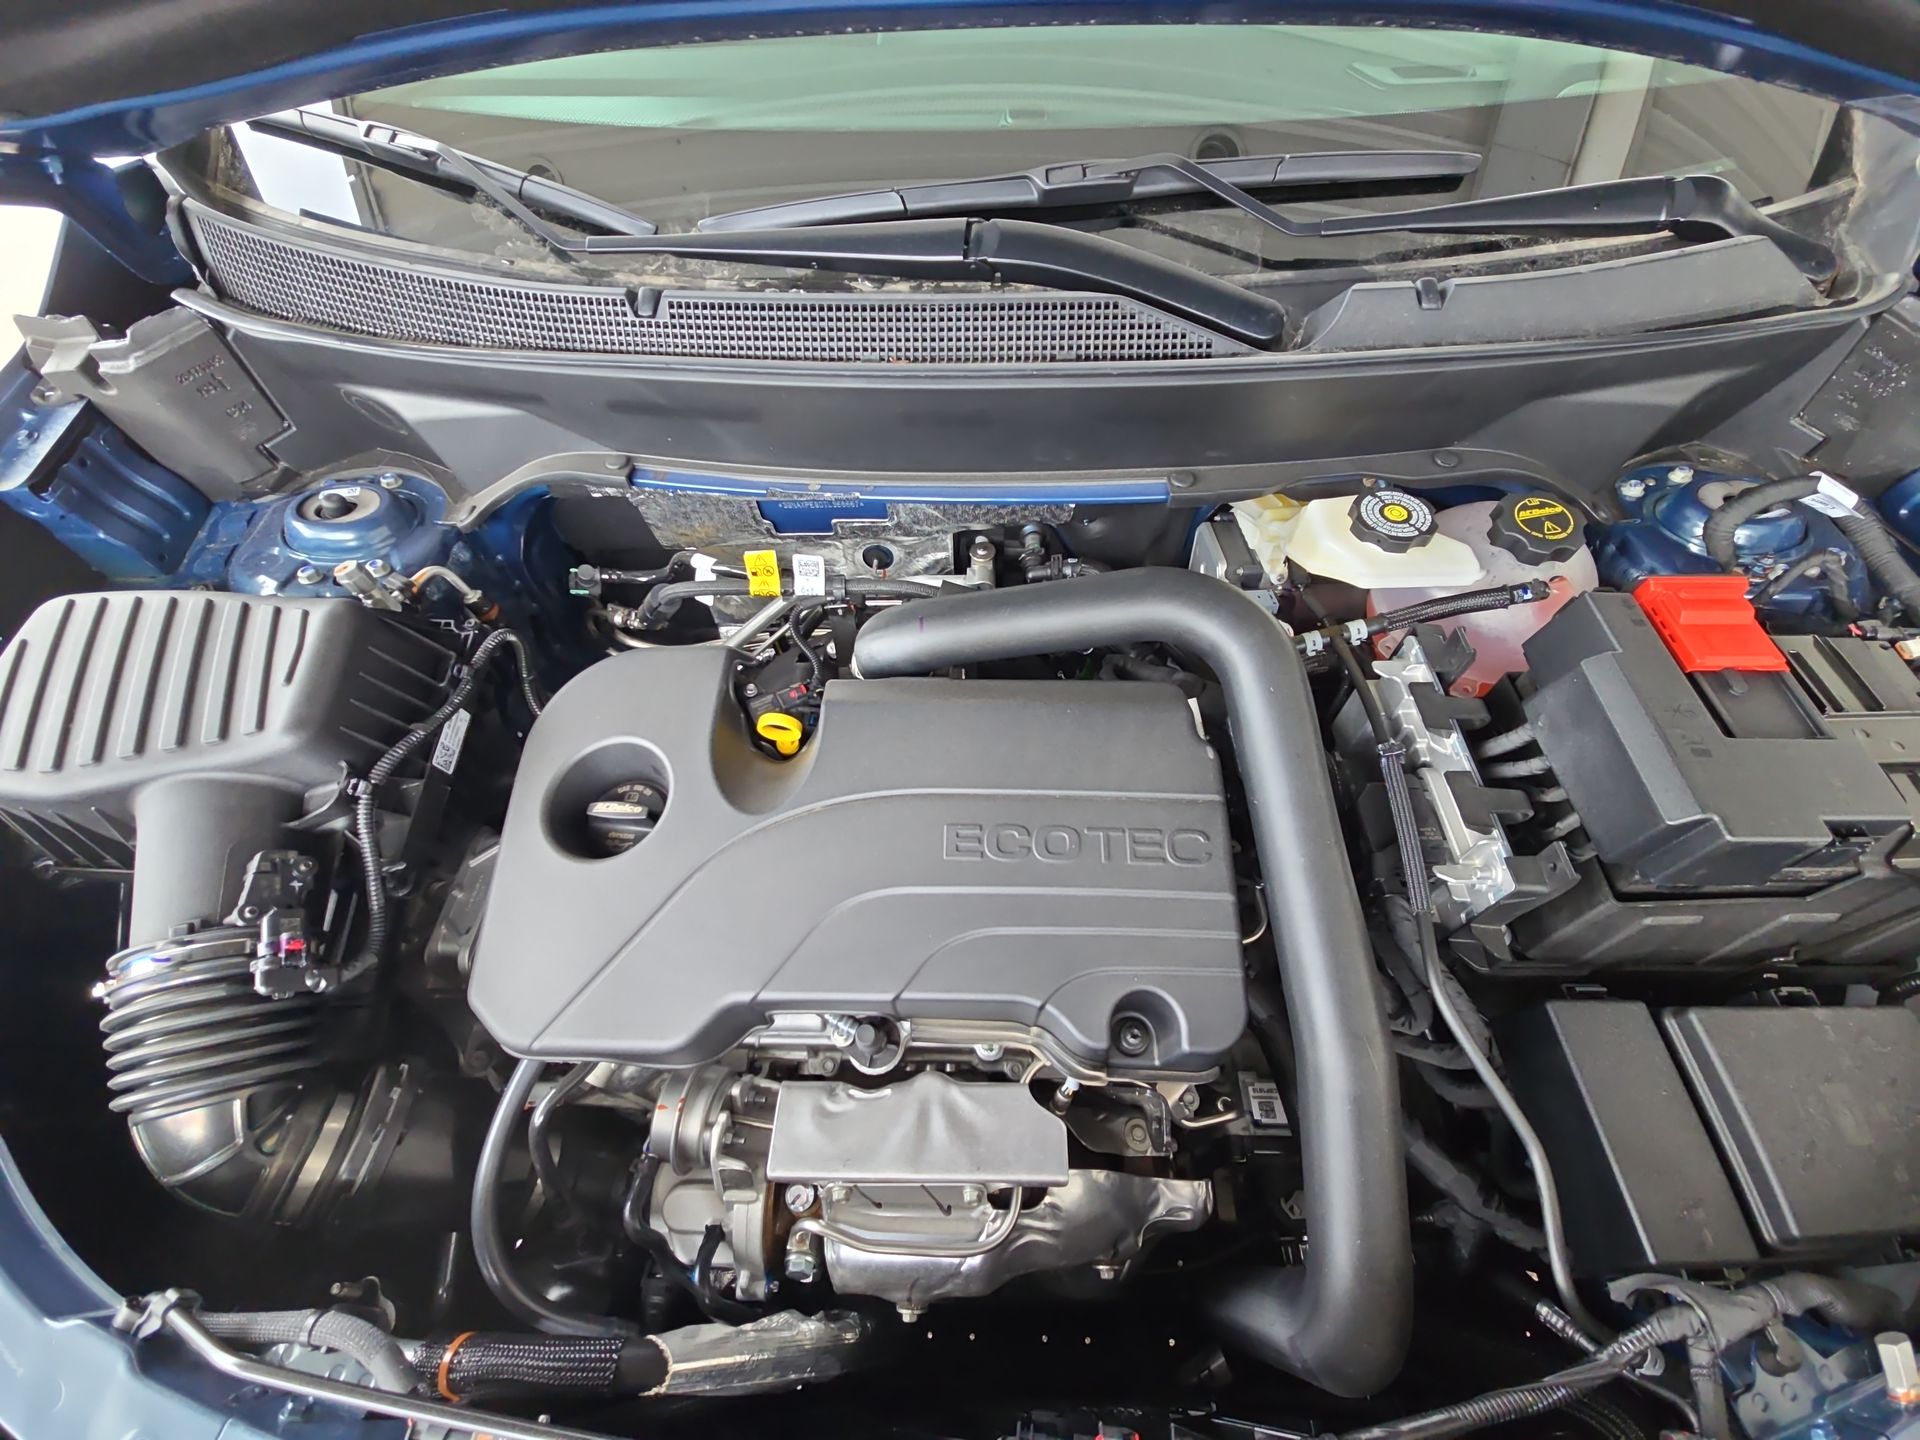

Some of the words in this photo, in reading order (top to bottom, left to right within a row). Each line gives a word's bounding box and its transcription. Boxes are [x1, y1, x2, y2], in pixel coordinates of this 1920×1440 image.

[1518, 506, 1563, 520] ACDelco
[591, 801, 643, 814] ACDelco
[943, 823, 1213, 867] ECOTEC
